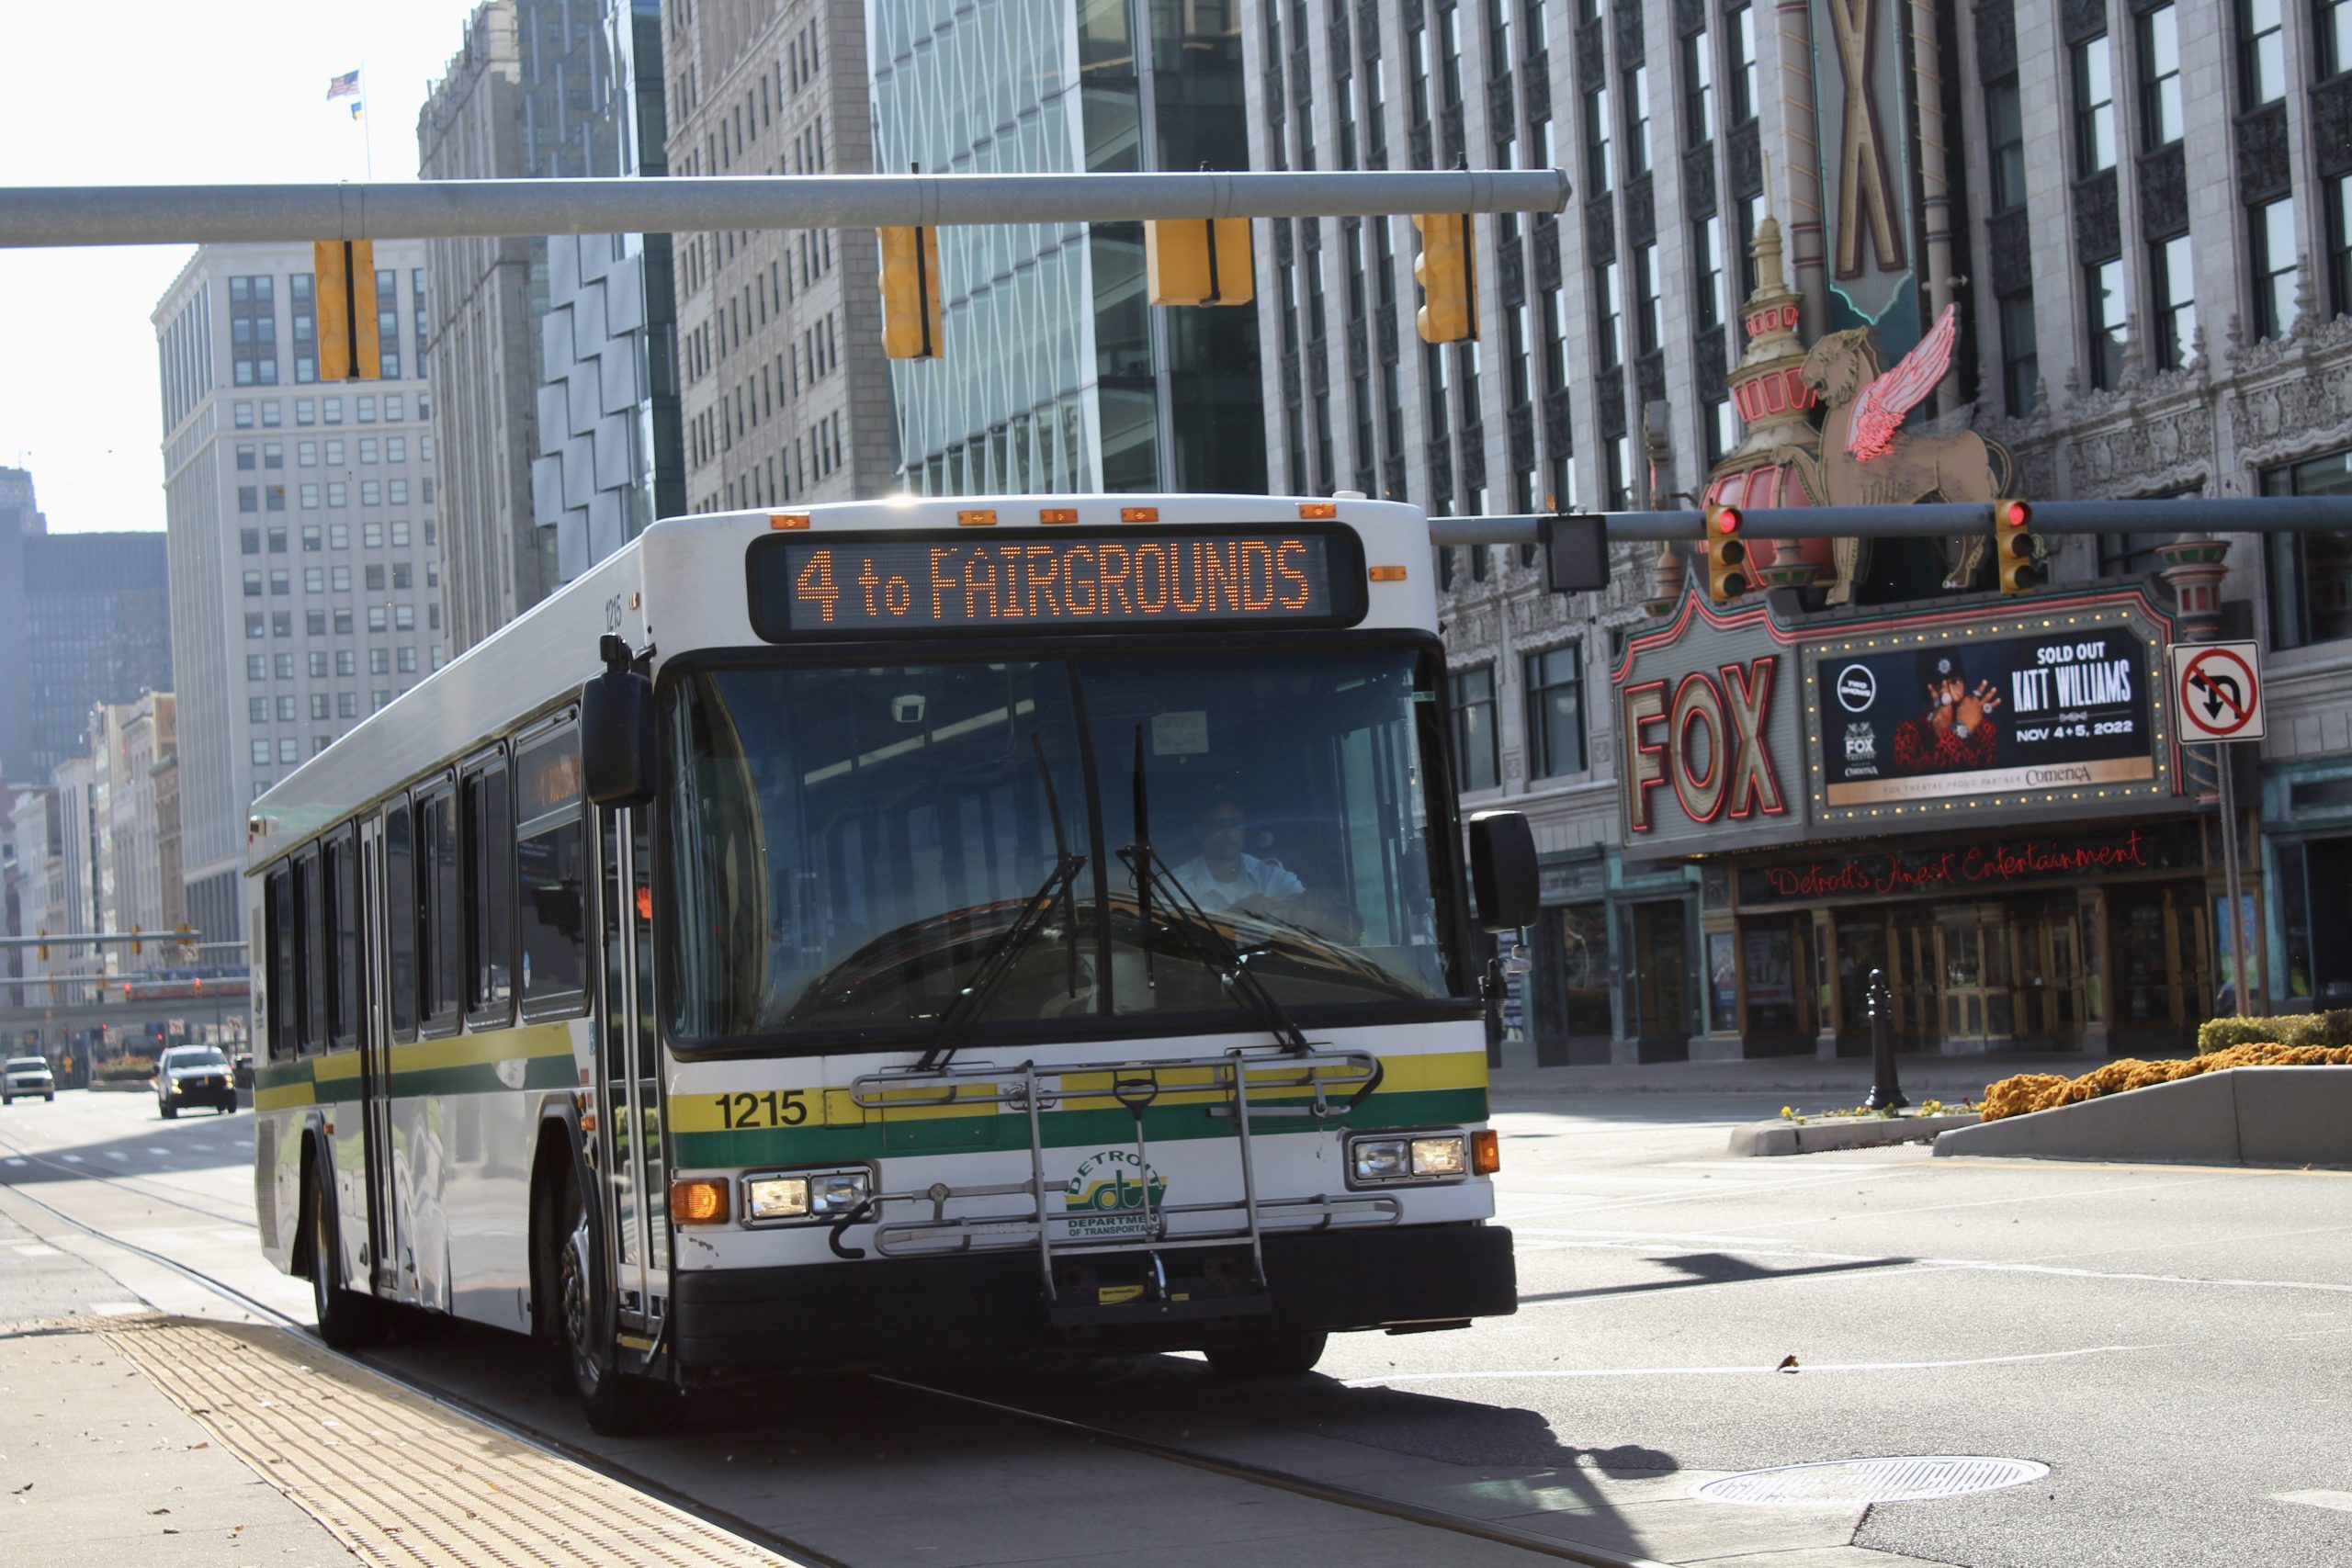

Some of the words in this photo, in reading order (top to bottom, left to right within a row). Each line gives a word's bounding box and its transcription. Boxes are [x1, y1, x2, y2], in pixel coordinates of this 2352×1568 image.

[797, 549, 840, 623] 4
[858, 558, 910, 617] to
[930, 540, 1309, 619] FAIRGROUNDS
[605, 594, 622, 632] 1215
[2037, 645, 2074, 665] SOLD
[2076, 641, 2106, 660] OUT
[2012, 668, 2050, 713] KATT
[2055, 659, 2132, 708] WILLIAMS
[1623, 655, 1786, 832] FOX
[1846, 738, 1874, 754] FOX
[2017, 728, 2050, 742] NOV
[2094, 720, 2133, 736] 2022
[1980, 776, 2021, 786] PARTNER
[1770, 860, 1870, 896] Detroit's
[1875, 852, 1956, 895] Finest
[1962, 829, 2146, 882] Entertainment
[716, 1090, 807, 1129] 1215
[1068, 1214, 1158, 1228] DEPARTMEN
[1069, 1228, 1082, 1236] OF
